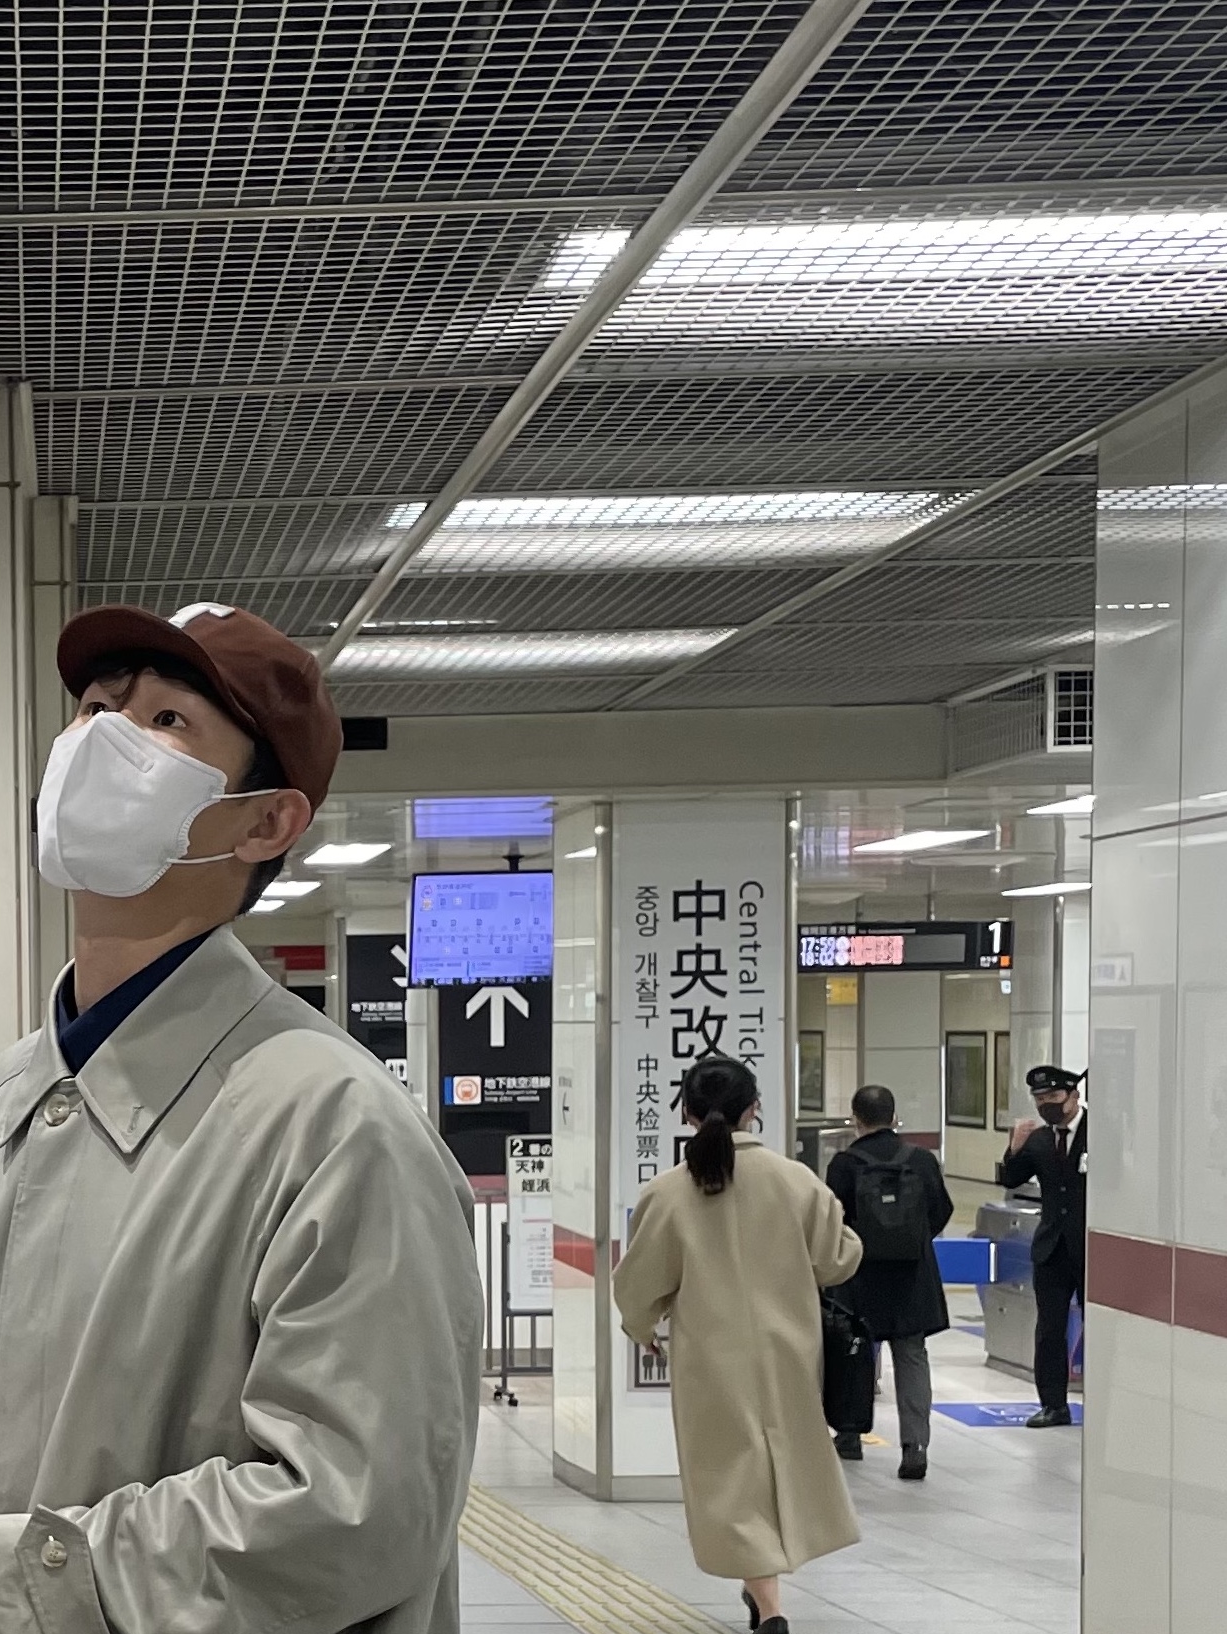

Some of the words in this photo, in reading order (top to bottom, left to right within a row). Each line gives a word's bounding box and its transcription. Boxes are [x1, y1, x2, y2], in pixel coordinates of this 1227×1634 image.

[635, 885, 660, 938] 중앙
[739, 880, 765, 994] Central
[988, 921, 1002, 954] 1
[635, 952, 660, 1029] 개찰구
[635, 1053, 660, 1185] 中央检票口
[515, 1159, 545, 1174] 天神
